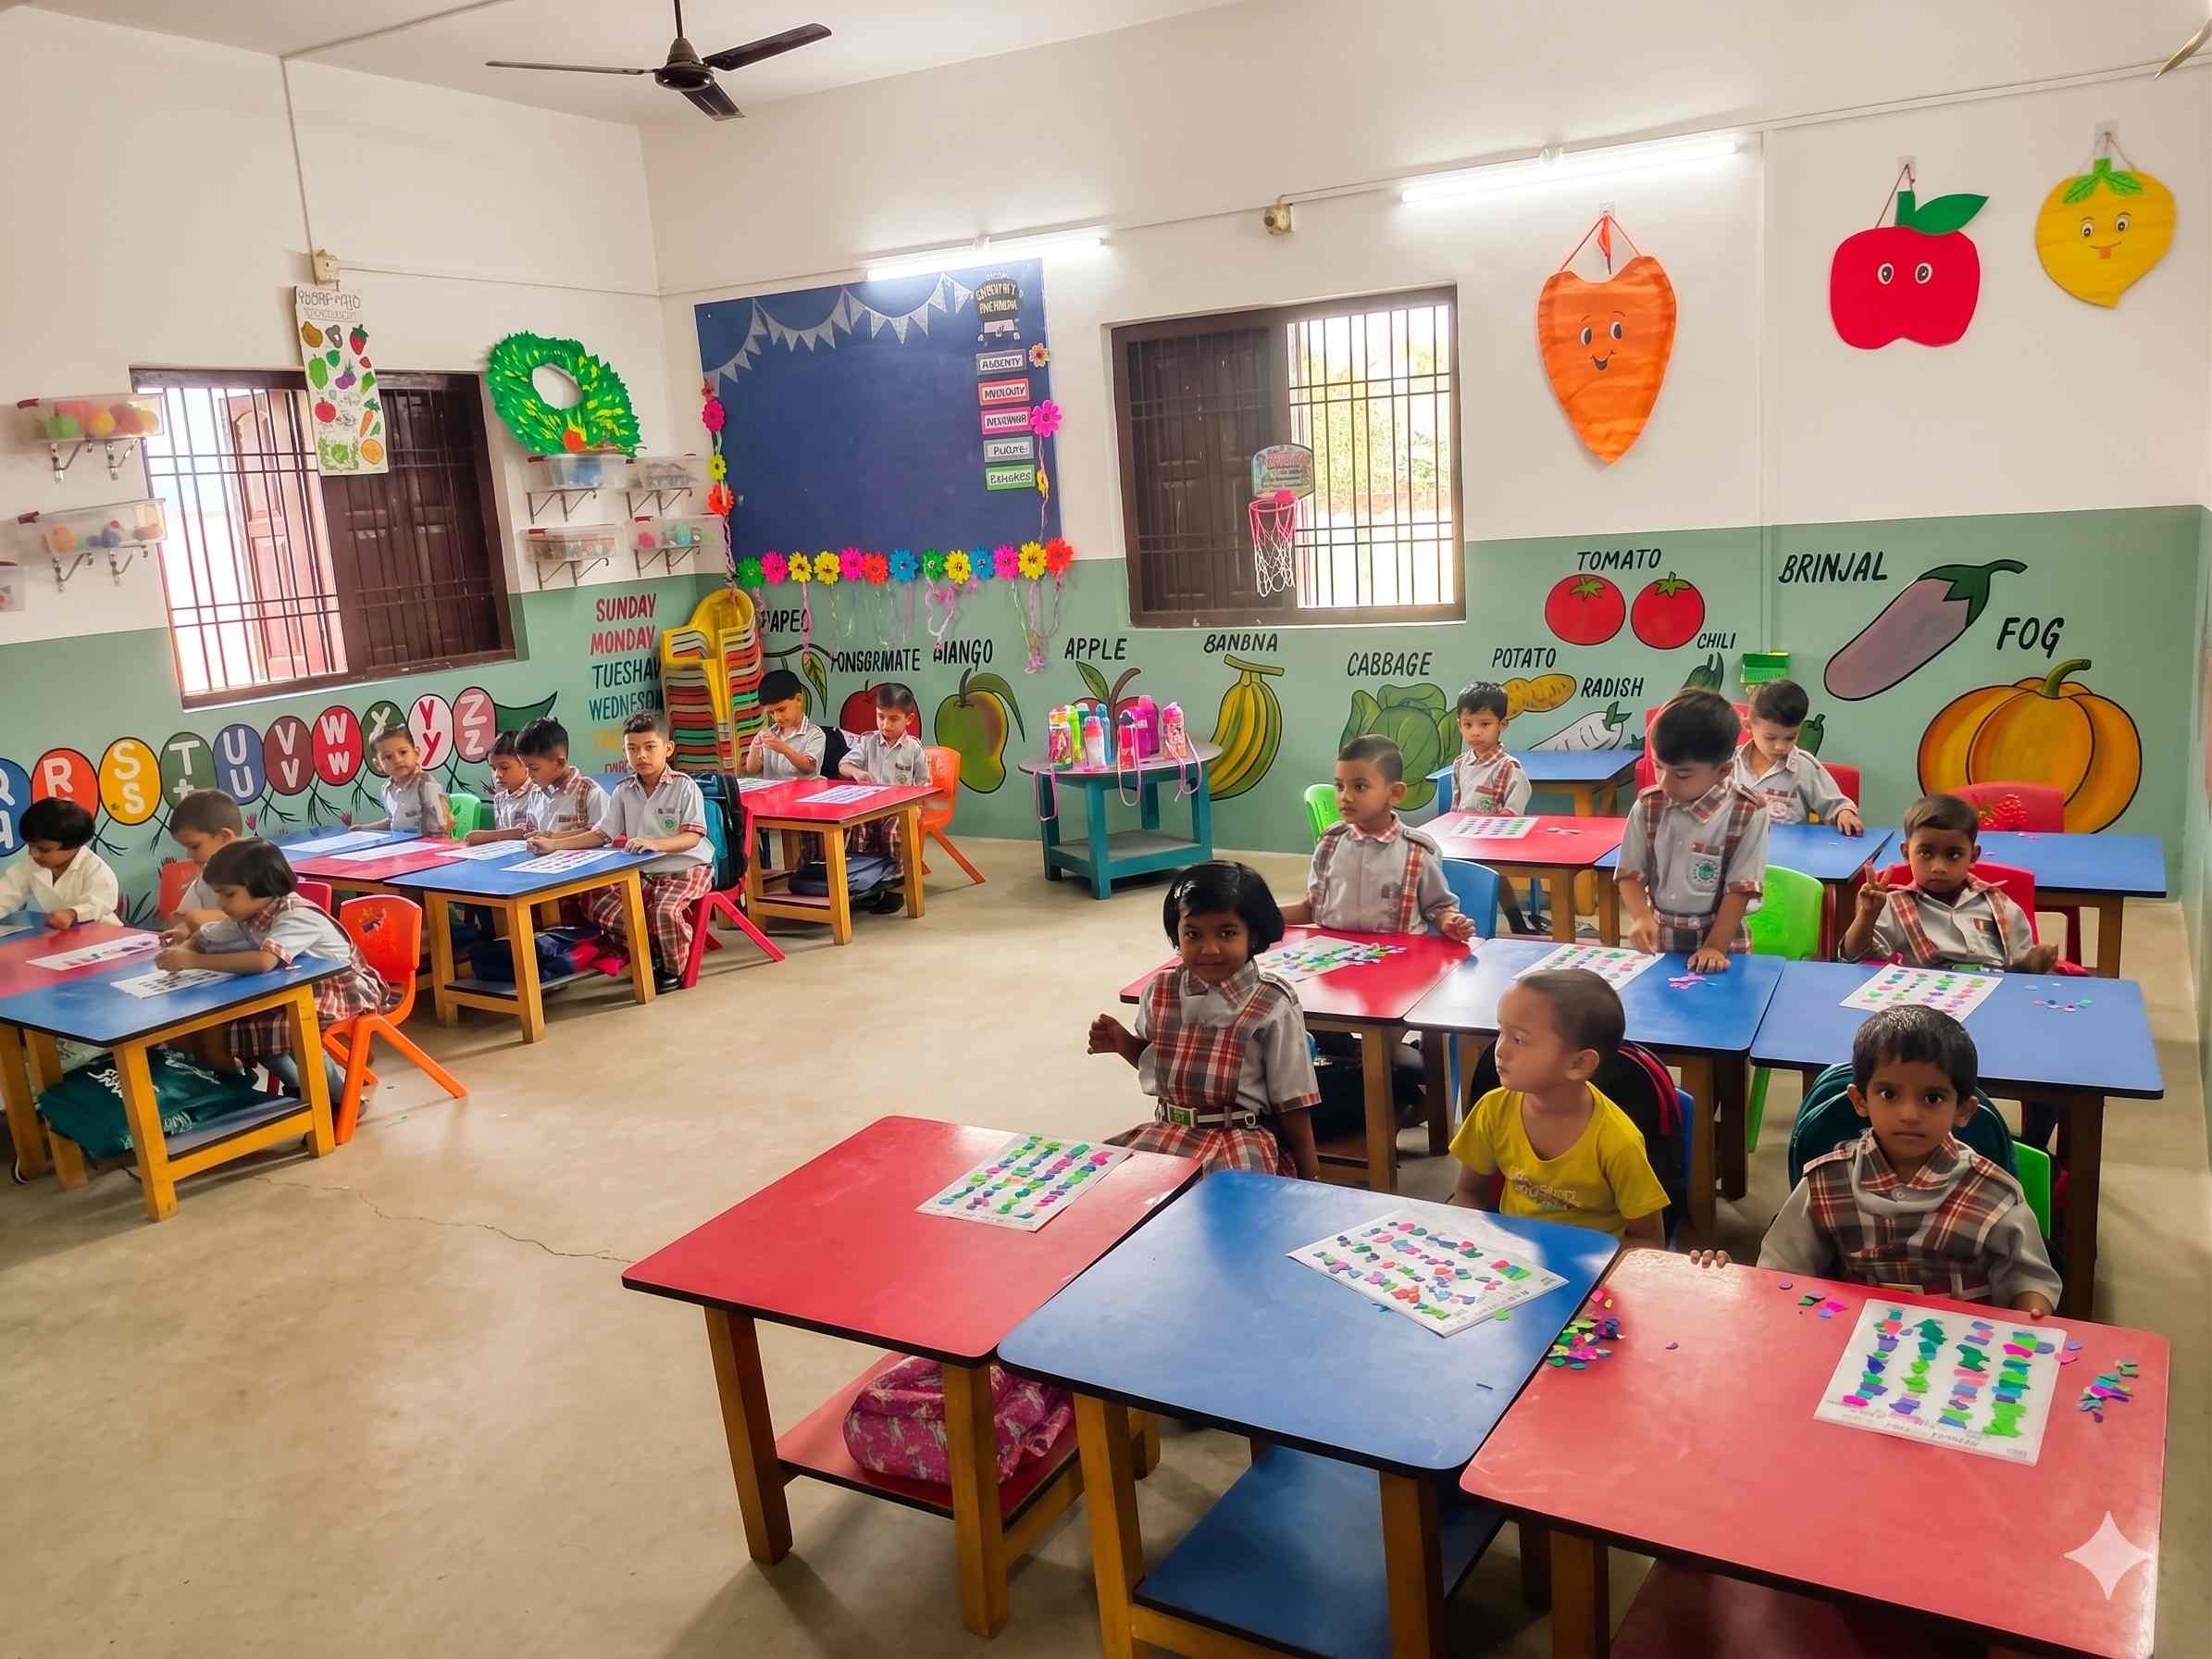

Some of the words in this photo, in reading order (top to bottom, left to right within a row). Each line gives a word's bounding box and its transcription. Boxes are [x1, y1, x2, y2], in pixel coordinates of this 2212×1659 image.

[1577, 548, 1661, 570] TOMATO
[1778, 552, 1888, 583] BRINJAL
[596, 593, 656, 622] SUNDAY
[590, 626, 655, 655] MONDAY
[1064, 638, 1127, 660] APPLE
[1204, 633, 1278, 654] BANBNA
[1696, 632, 1736, 650] CHILI
[1996, 617, 2065, 659] FOG
[1347, 651, 1434, 677] CABBAGE
[1492, 648, 1557, 668] POTATO
[1581, 677, 1644, 698] RADISH
